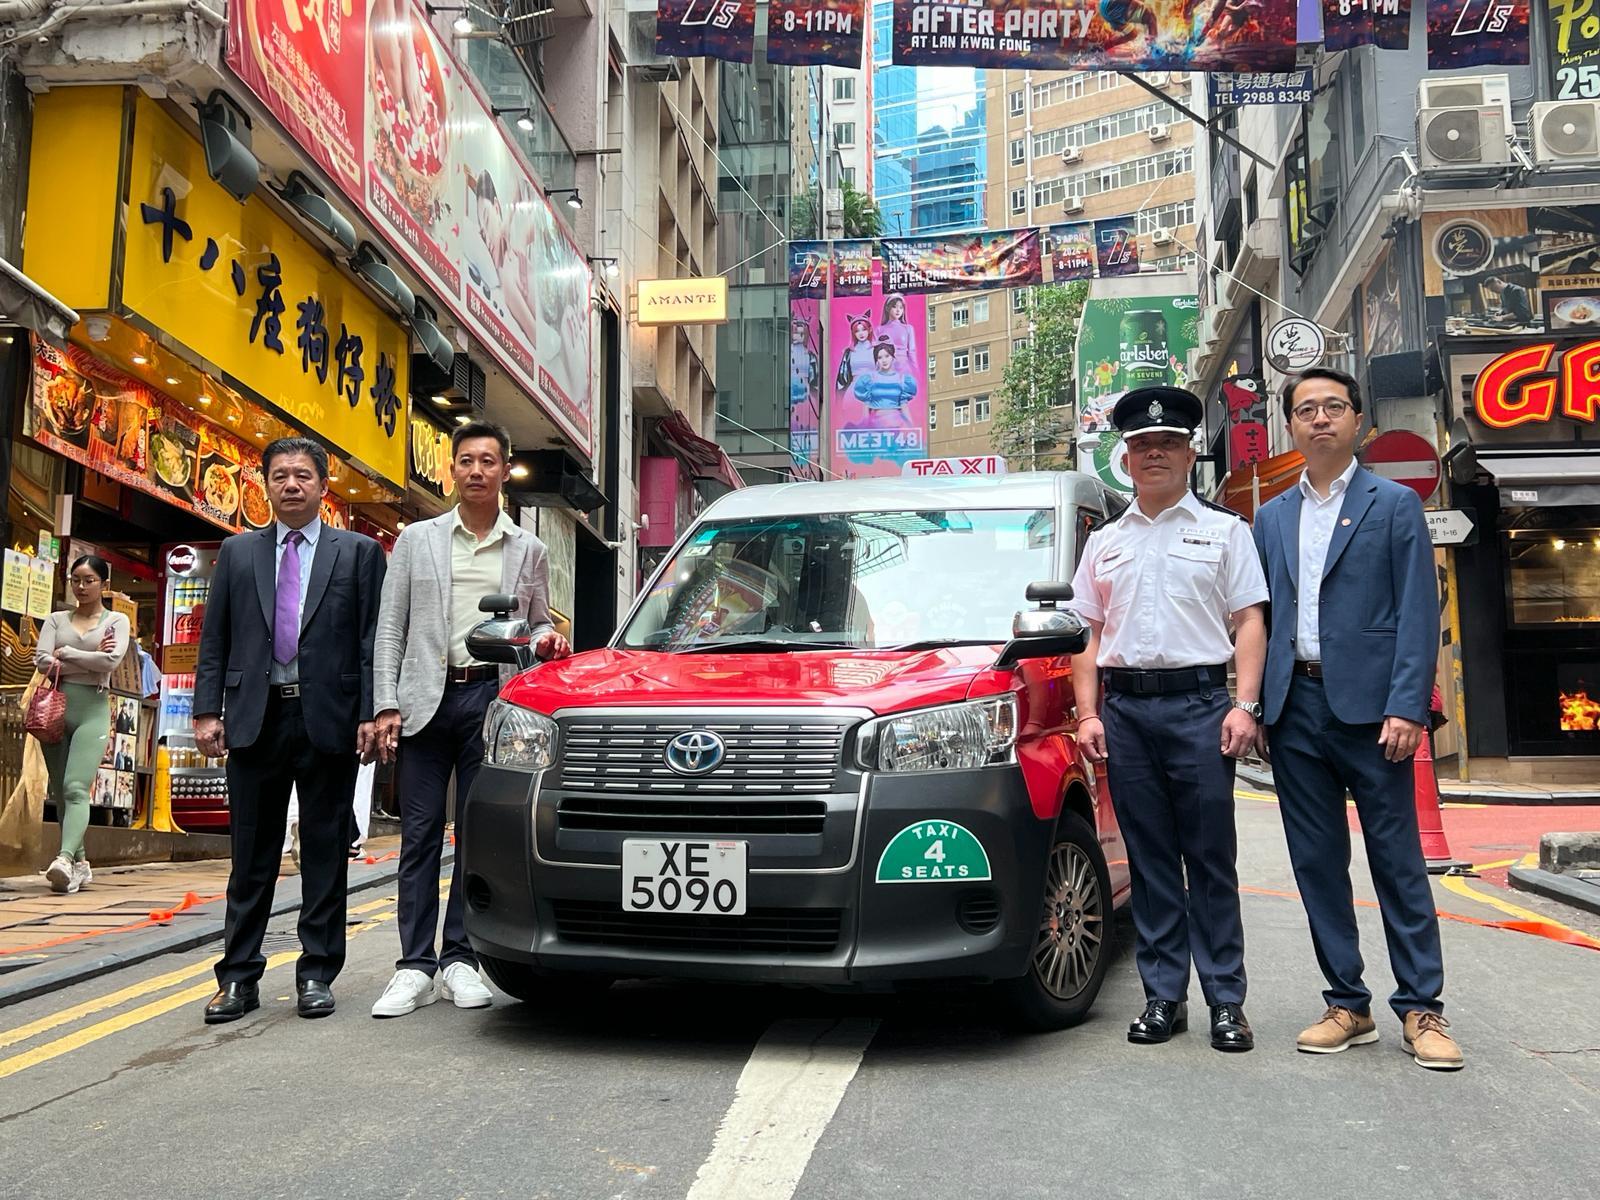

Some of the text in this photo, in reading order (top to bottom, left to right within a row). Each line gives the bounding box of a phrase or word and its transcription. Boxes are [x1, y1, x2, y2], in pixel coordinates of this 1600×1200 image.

[783, 10, 852, 35] 8-11PM
[912, 6, 1093, 39] AFTER PARTY
[911, 36, 1031, 52] AT LAN KWAI FONG
[1556, 65, 1600, 100] 25
[1215, 90, 1311, 105] TEL: 2988 8348
[388, 200, 403, 230] Foot
[404, 219, 420, 247] bath
[1063, 231, 1086, 243] APRIL
[846, 250, 868, 259] APRIL
[1062, 247, 1081, 257] 2024
[1058, 258, 1088, 270] 8-11PM
[839, 275, 868, 285] 8-11PM
[889, 271, 925, 284] AFTER
[647, 294, 717, 306] AMANTE
[140, 186, 402, 438] 十八座狗仔粉
[911, 457, 996, 476] TAXI
[1426, 516, 1448, 525] ane
[1442, 529, 1458, 537] 1-16
[911, 823, 959, 840] TAXI
[923, 839, 947, 864] 4
[658, 842, 710, 877] XE
[901, 864, 970, 878] SEATS
[630, 875, 738, 913] 5090
